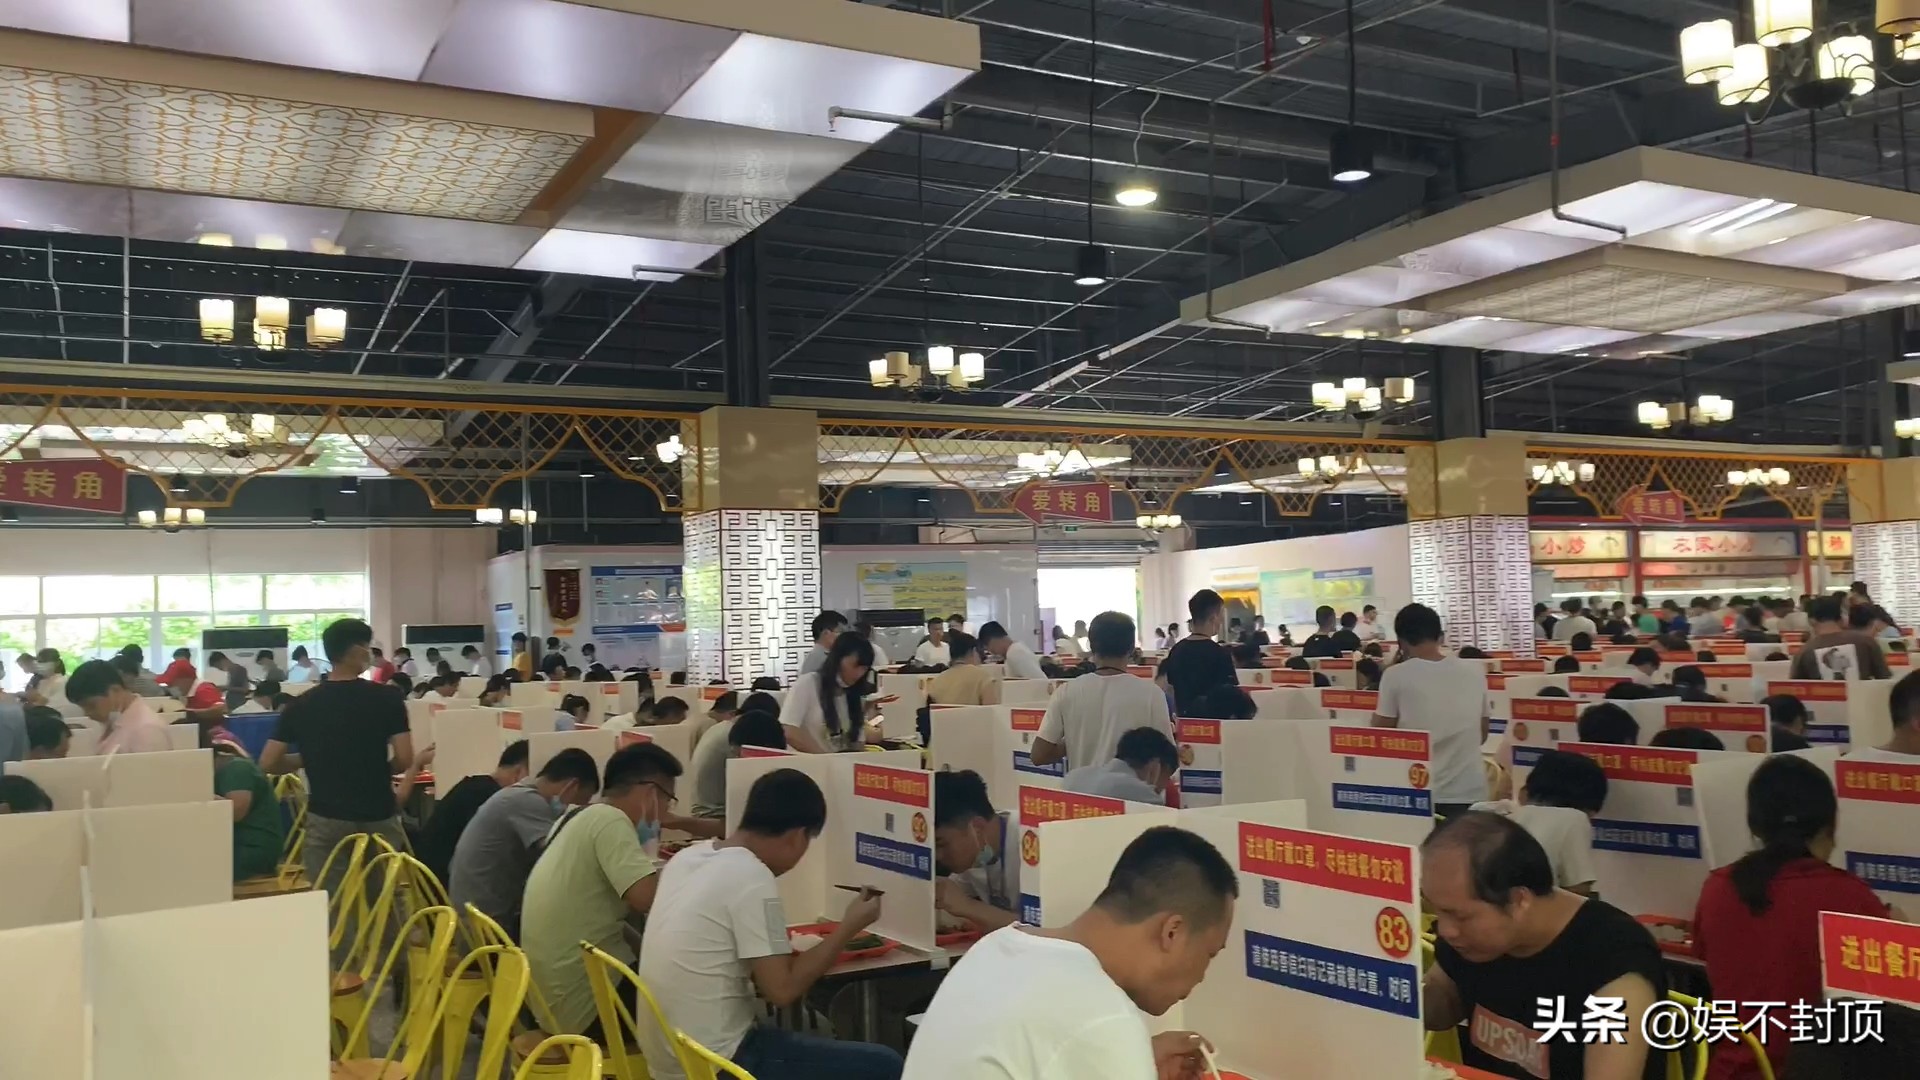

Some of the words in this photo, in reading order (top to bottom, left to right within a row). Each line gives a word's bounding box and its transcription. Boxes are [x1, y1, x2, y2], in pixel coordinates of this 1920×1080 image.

[0, 467, 104, 500] 转角
[1031, 489, 1101, 513] 爱转角
[1531, 535, 1586, 556] 小炒
[1411, 767, 1428, 787] 97
[1022, 834, 1040, 862] 84
[1378, 914, 1410, 952] 83
